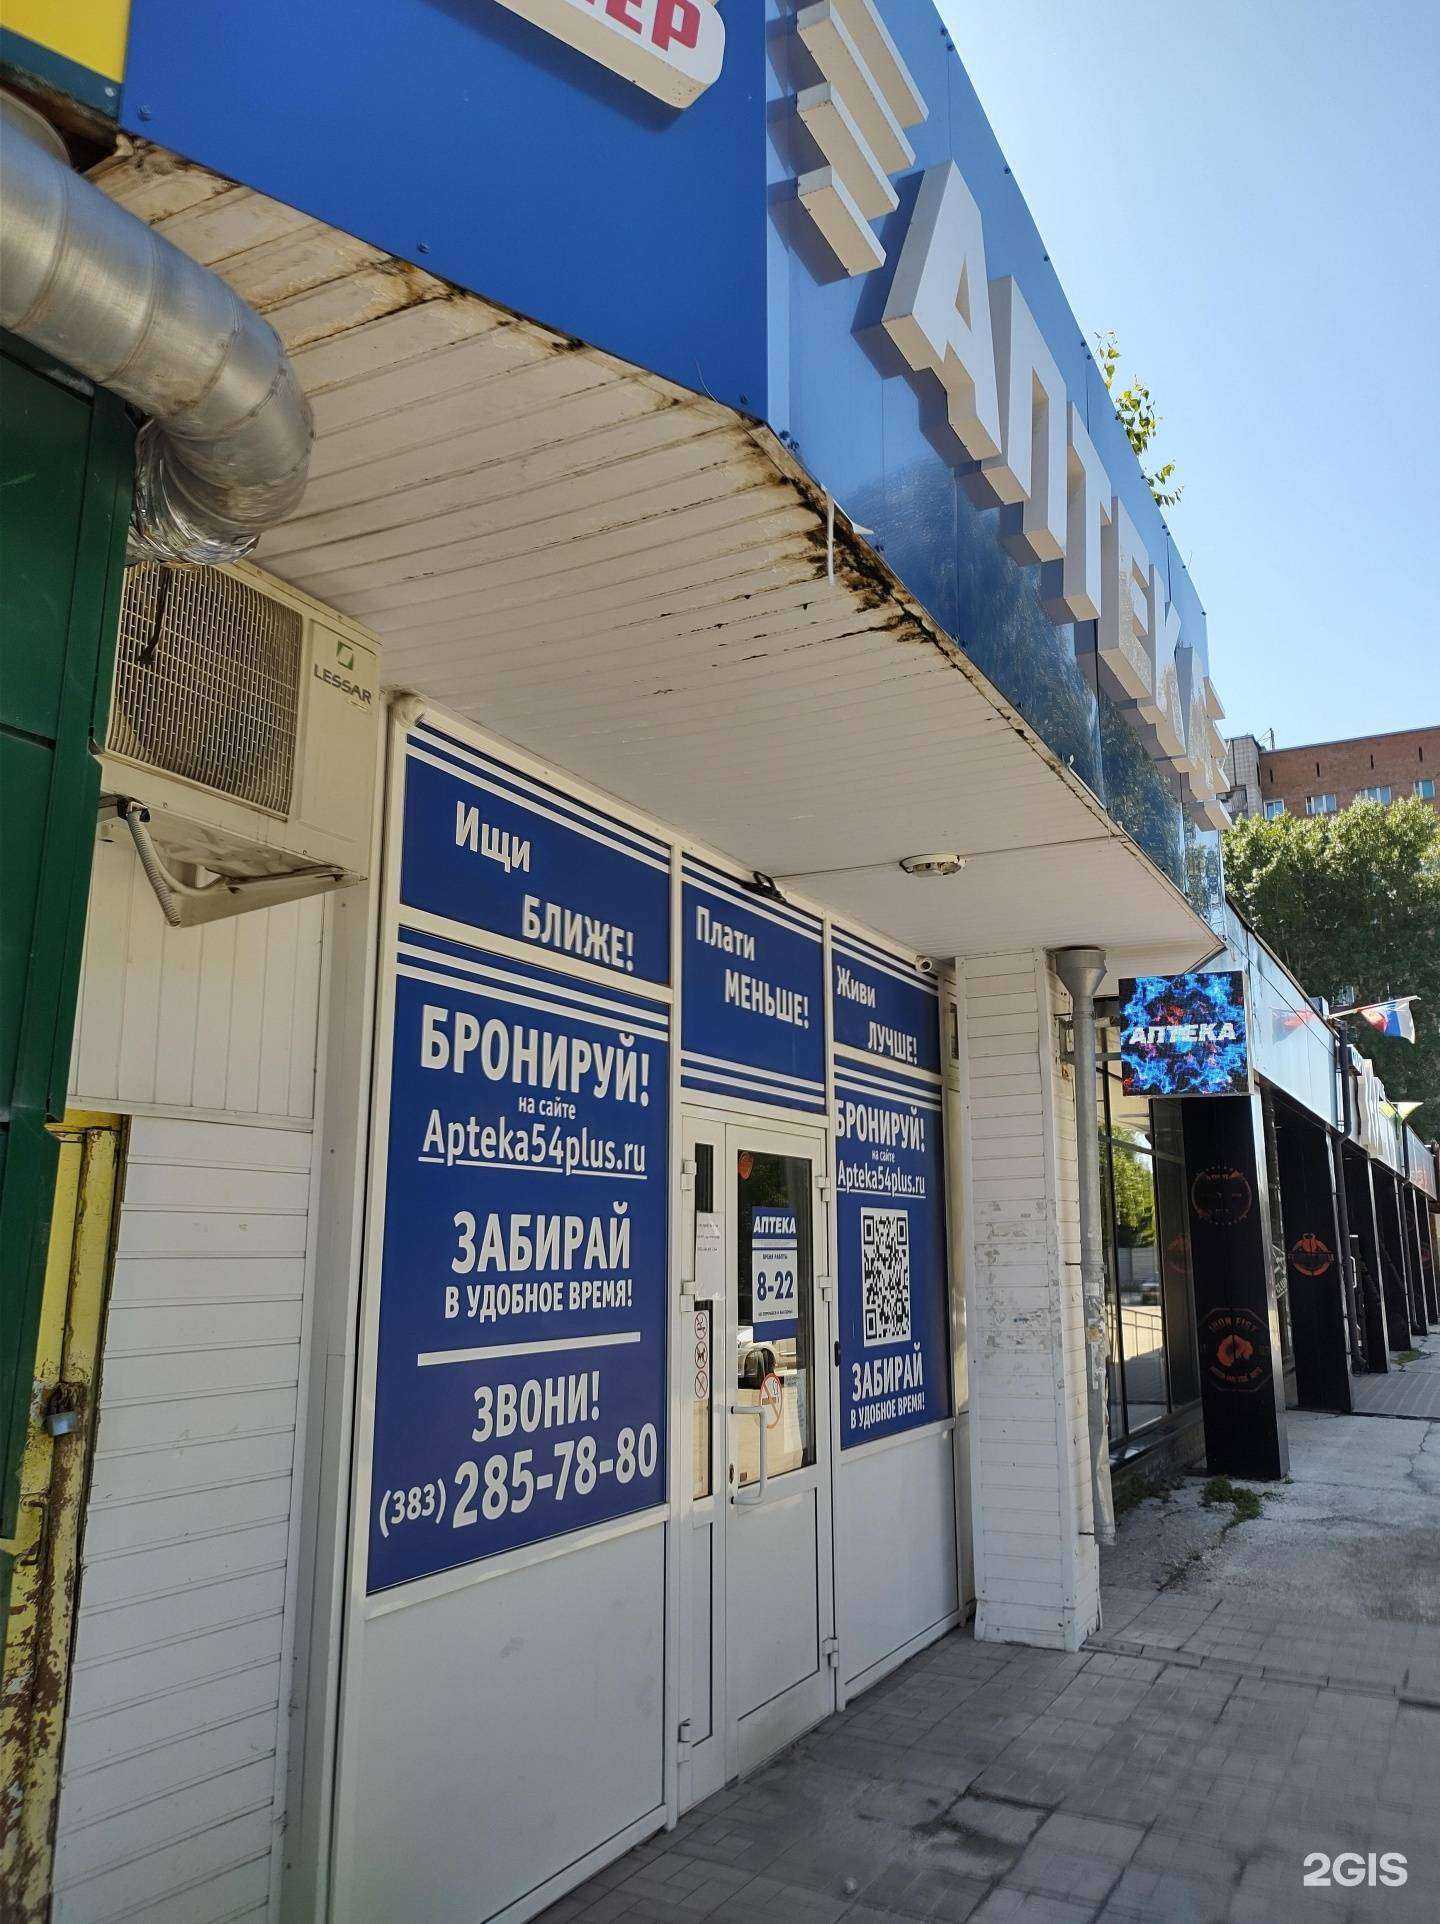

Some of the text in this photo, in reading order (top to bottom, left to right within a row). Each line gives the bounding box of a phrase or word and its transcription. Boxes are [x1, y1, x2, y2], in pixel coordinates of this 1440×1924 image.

[882, 160, 1216, 800] АПТЕКА
[313, 663, 372, 705] LESSAR
[454, 800, 531, 873] Ищи
[521, 893, 634, 972] БЛИЖЕ!
[695, 904, 757, 961] Плати
[724, 967, 809, 1029] МЕНЬШЕ!
[836, 964, 877, 1009] Живи
[420, 1003, 649, 1107] БРОНИРУЙ!
[867, 1020, 918, 1064] ЛУЧШЕ!
[1129, 1022, 1236, 1044] АПТЕКА
[517, 1095, 577, 1121] на сайте
[836, 1098, 925, 1153] БРОНИРУЙ!
[422, 1108, 647, 1177] Apteka54plus.ru
[871, 1150, 896, 1164] на сайте
[838, 1159, 926, 1198] Apteka54plus.ru
[451, 1200, 631, 1274] ЗАБИРАЙ
[753, 1215, 796, 1234] АПТЕКА
[444, 1277, 633, 1323] В УДОБНОЕ ВРЕМЯ!
[757, 1270, 794, 1301] 8-22
[851, 1341, 924, 1402] ЗАБИРАЙ
[471, 1369, 601, 1443] ЗВОНИ!
[850, 1391, 925, 1430] В УДОБНОЕ ВРЕМЯ!
[379, 1421, 659, 1538] (383) 285-78-80
